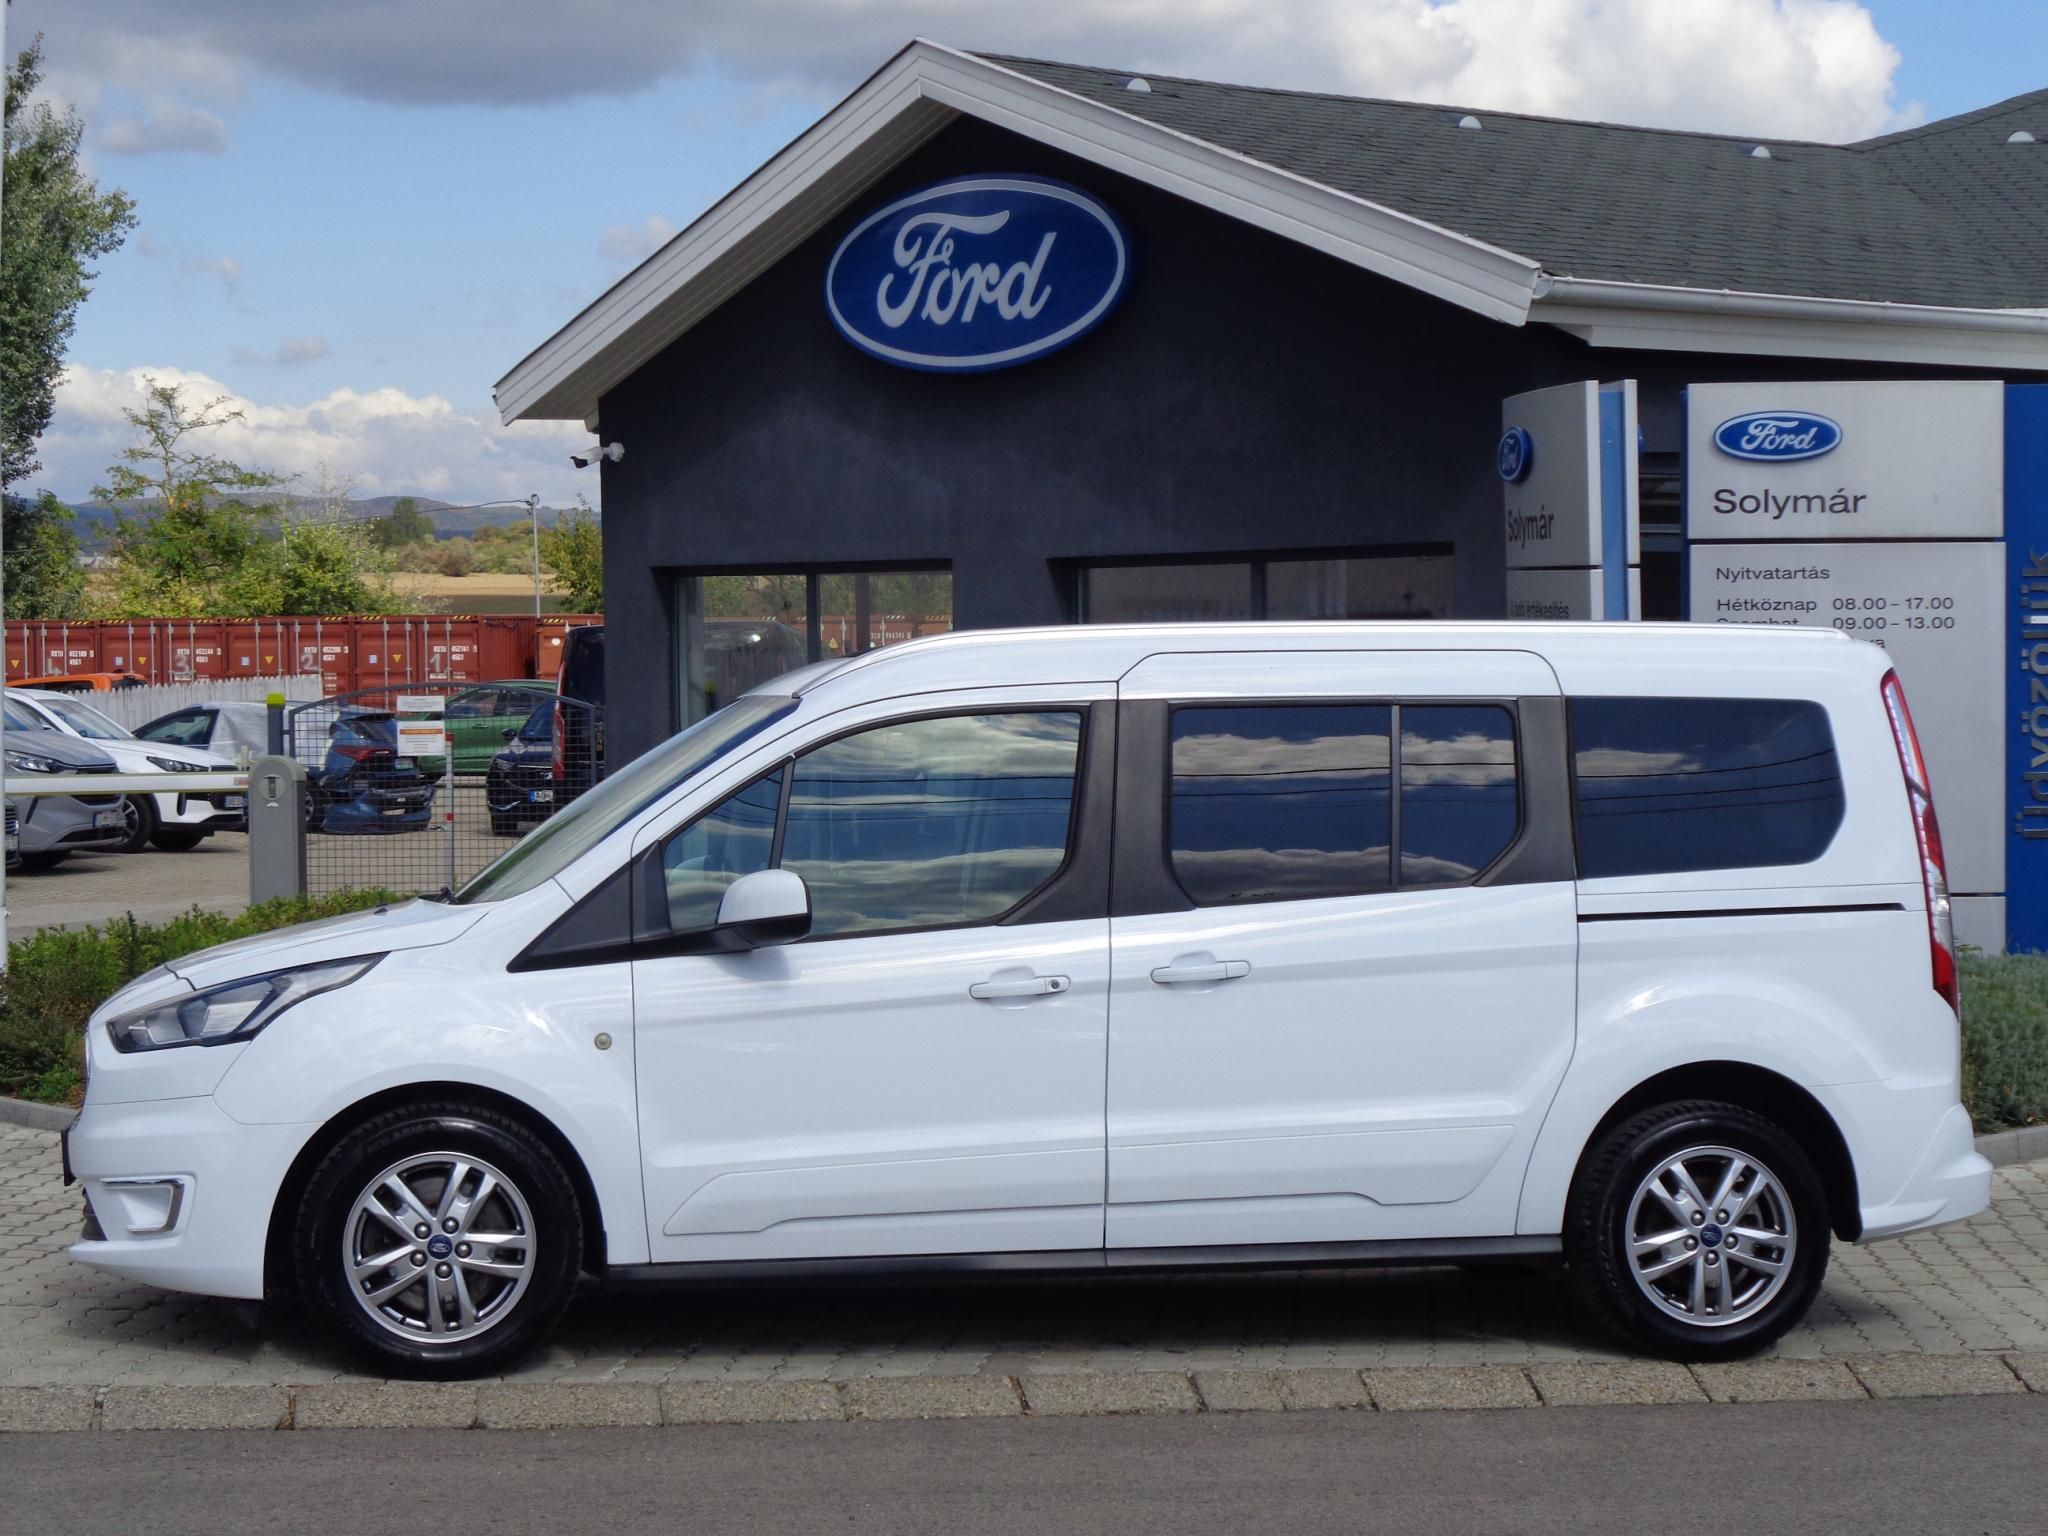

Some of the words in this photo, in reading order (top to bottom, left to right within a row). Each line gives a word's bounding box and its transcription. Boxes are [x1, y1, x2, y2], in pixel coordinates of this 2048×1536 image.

[877, 210, 1057, 328] Ford
[1740, 419, 1819, 450] Ford
[1713, 488, 1867, 520] Solymár
[1507, 505, 1554, 549] Solymár
[1716, 566, 1831, 583] Nyitvatartás
[1717, 598, 1817, 614] Hétköznap
[1832, 597, 1887, 611] 08.00
[1904, 597, 1955, 610] 17.00
[1832, 617, 1887, 630] 09.00
[1904, 616, 1955, 629] 13.00
